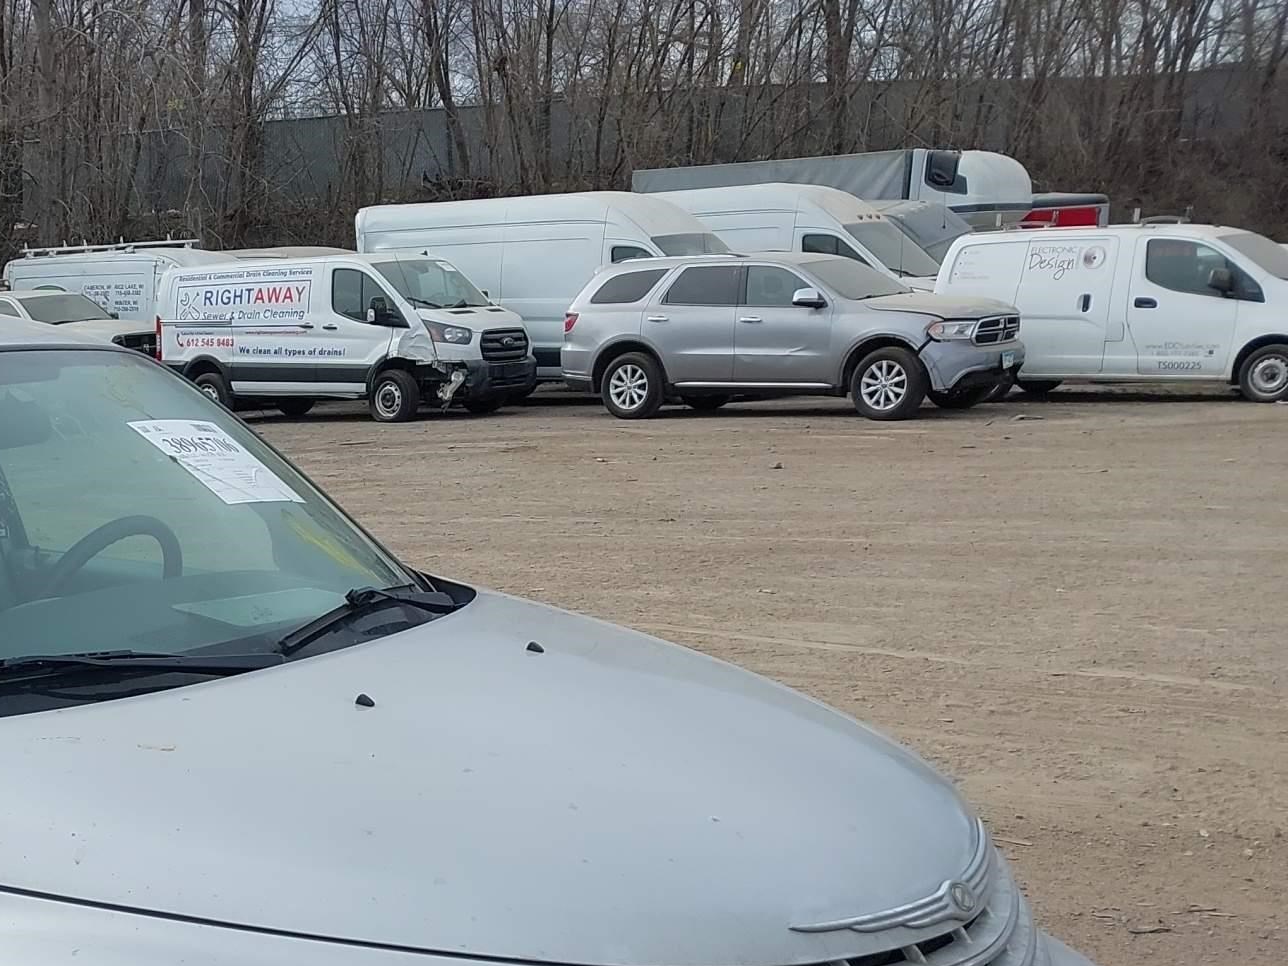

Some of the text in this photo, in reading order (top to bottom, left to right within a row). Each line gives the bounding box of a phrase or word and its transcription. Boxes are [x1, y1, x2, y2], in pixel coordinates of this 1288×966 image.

[1029, 253, 1074, 280] Design
[203, 286, 306, 306] RIGHTAWAY
[202, 312, 227, 320] Sewer
[238, 310, 261, 320] Drain
[263, 308, 305, 321] Cleaning
[186, 338, 199, 347] 612
[201, 338, 215, 347] 545
[252, 346, 271, 354] clean
[273, 346, 283, 354] all
[284, 348, 306, 357] types
[307, 347, 317, 356] of
[318, 347, 346, 356] drains!
